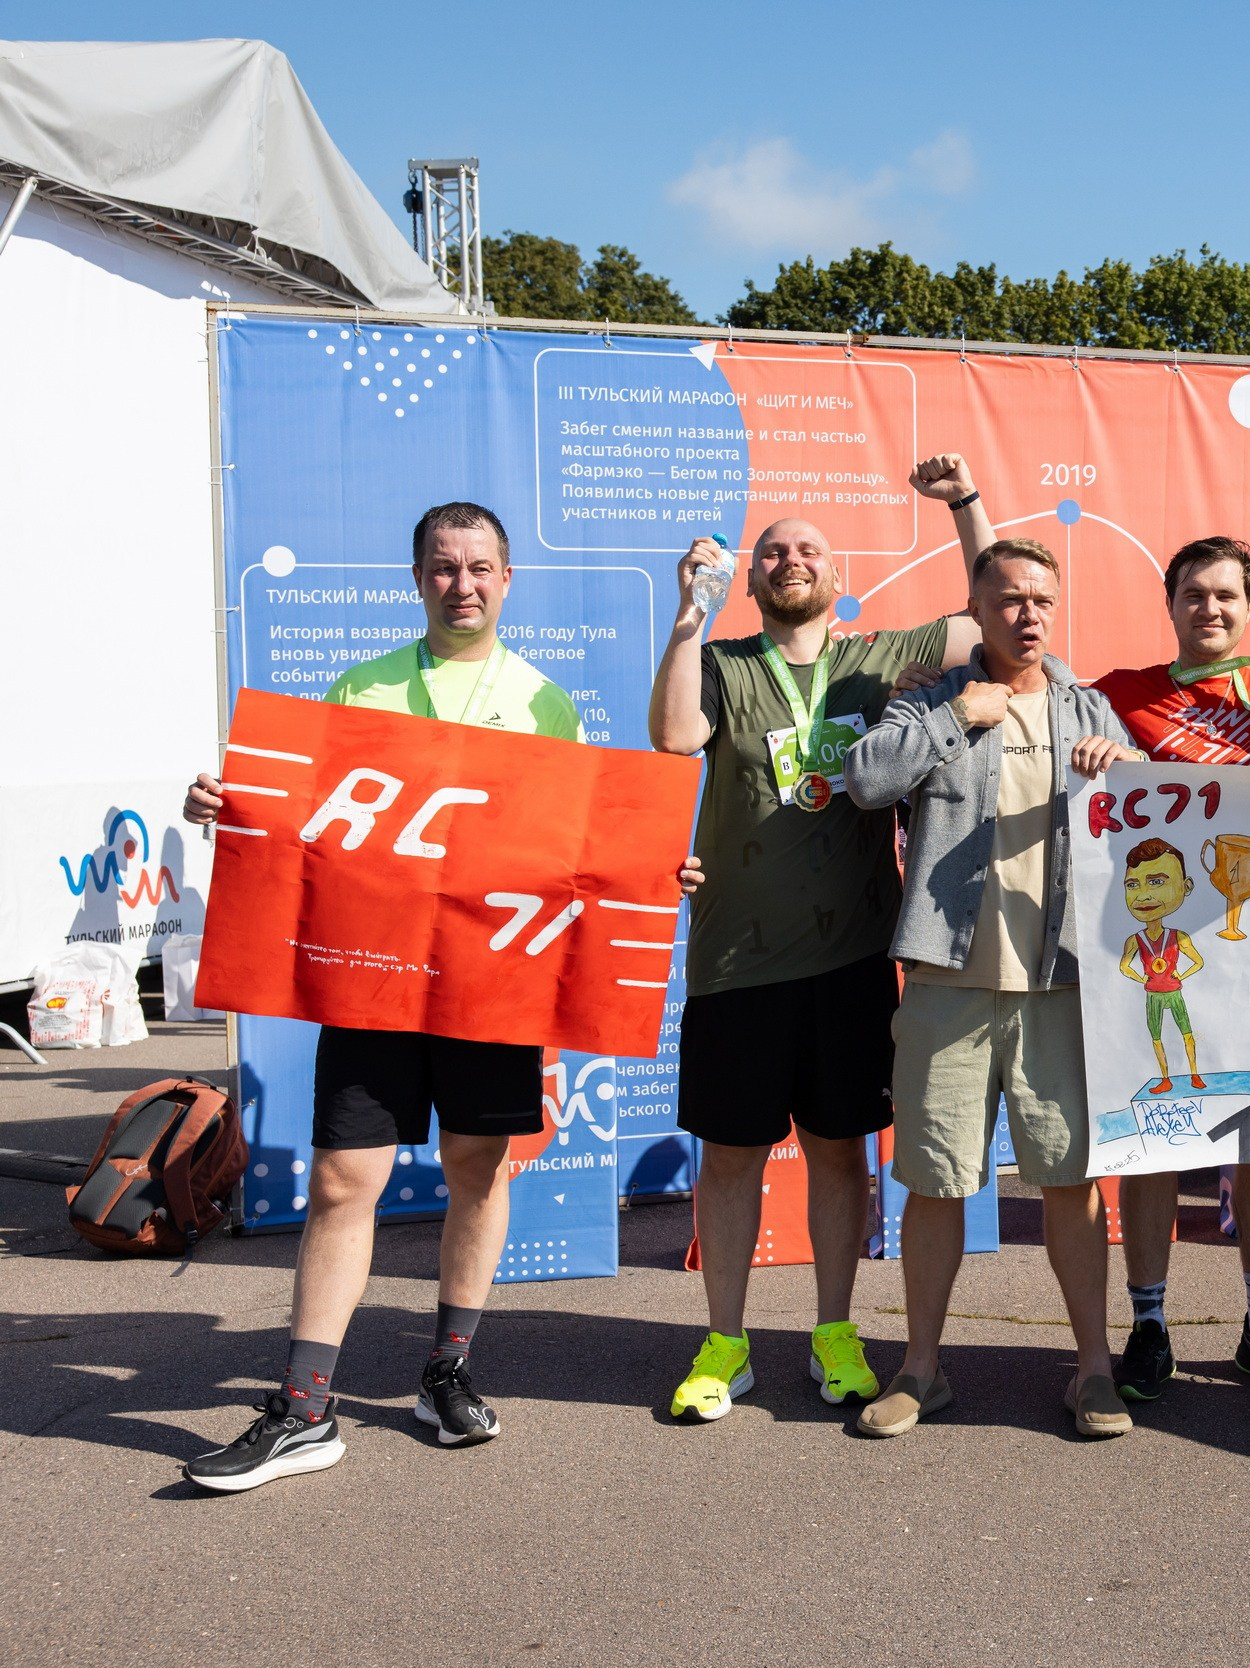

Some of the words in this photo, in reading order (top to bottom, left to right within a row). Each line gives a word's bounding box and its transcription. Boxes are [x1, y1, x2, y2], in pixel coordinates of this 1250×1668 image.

[578, 386, 662, 404] ТУЛЬСКИЙ
[668, 391, 747, 406] МАРАФОН
[756, 395, 797, 410] «ЩИТ
[802, 396, 812, 408] И
[816, 396, 854, 410] МЕЧ»
[560, 421, 608, 436] Забег
[612, 425, 672, 438] сменил
[678, 427, 754, 440] название
[759, 430, 768, 441] и
[773, 430, 806, 442] стал
[811, 431, 866, 444] частью
[561, 442, 670, 459] масштабного
[675, 449, 740, 463] проекта
[561, 464, 643, 481] «Фармэко
[670, 466, 718, 482] Бегом
[722, 471, 742, 483] по
[746, 468, 821, 486] Золотому
[825, 472, 889, 486] кольцу».
[1040, 463, 1096, 486] 2019
[562, 484, 653, 500] Появились
[658, 488, 709, 501] новые
[714, 490, 798, 504] дистанции
[802, 492, 830, 506] для
[835, 493, 909, 507] взрослых
[562, 508, 657, 523] участников
[662, 510, 671, 521] и
[676, 507, 722, 524] детей
[266, 586, 358, 604] ТУЛЬСКИЙ
[364, 590, 424, 604] МАРАФ
[270, 625, 344, 642] История
[350, 628, 426, 642] возвращ
[499, 626, 535, 640] 2016
[540, 628, 575, 643] году
[580, 625, 616, 640] Тула
[270, 648, 325, 662] вновь
[330, 648, 397, 663] увиде
[518, 646, 586, 660] беговое
[584, 708, 611, 723] (10,
[300, 767, 489, 859] RC
[129, 918, 182, 940] МАРАФОН
[484, 892, 584, 956] 71
[620, 1102, 671, 1118] ьского
[508, 1152, 594, 1174] ТУЛЬСКИЙ
